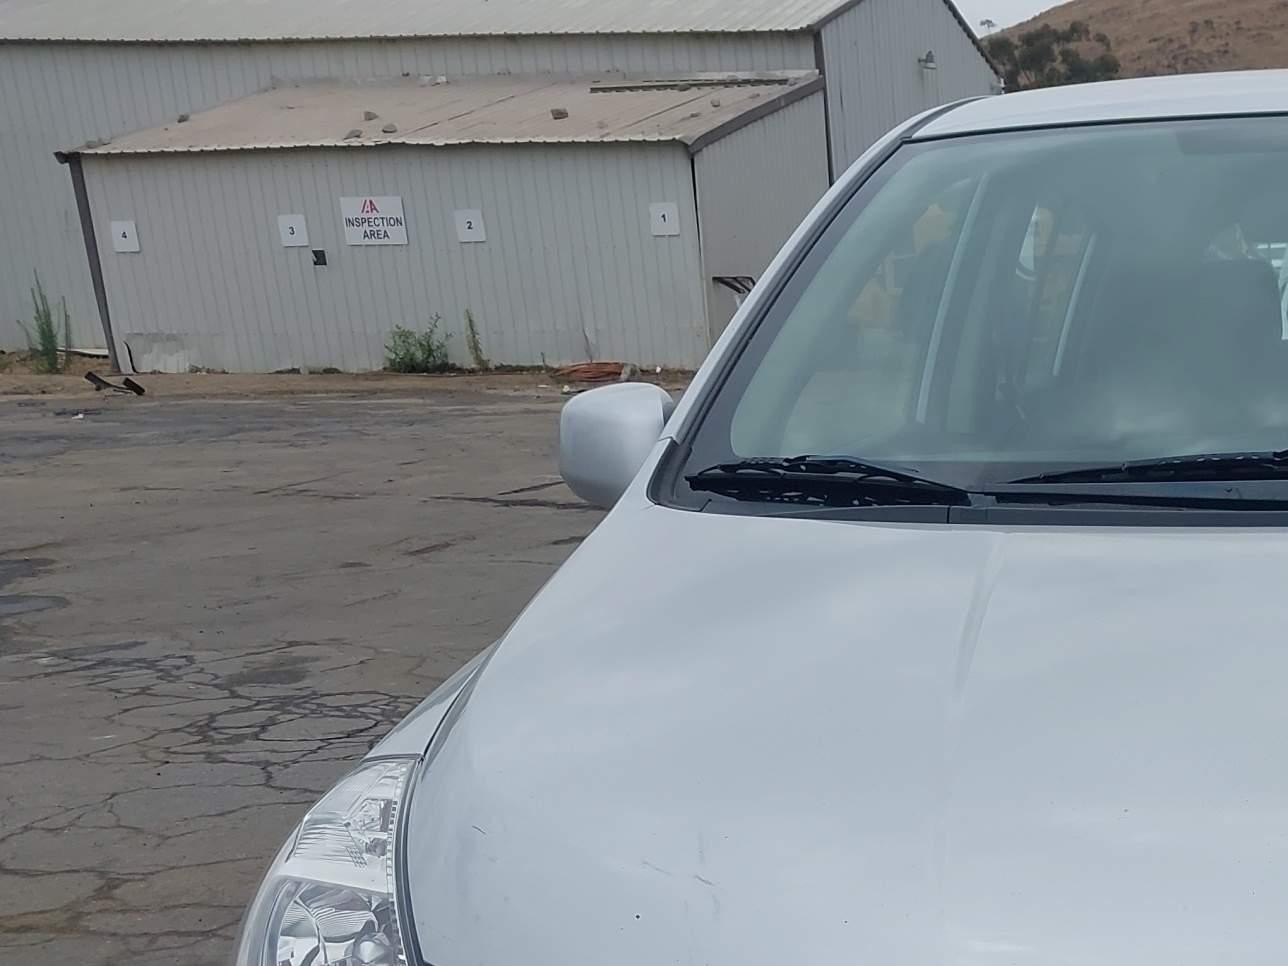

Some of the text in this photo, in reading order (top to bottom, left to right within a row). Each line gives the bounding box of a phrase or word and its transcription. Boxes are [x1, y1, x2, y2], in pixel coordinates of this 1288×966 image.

[345, 216, 403, 227] INSPECTION
[661, 213, 666, 223] 1
[466, 220, 473, 230] 2
[121, 231, 128, 239] 4
[288, 226, 295, 235] 3
[363, 229, 390, 240] AREA
